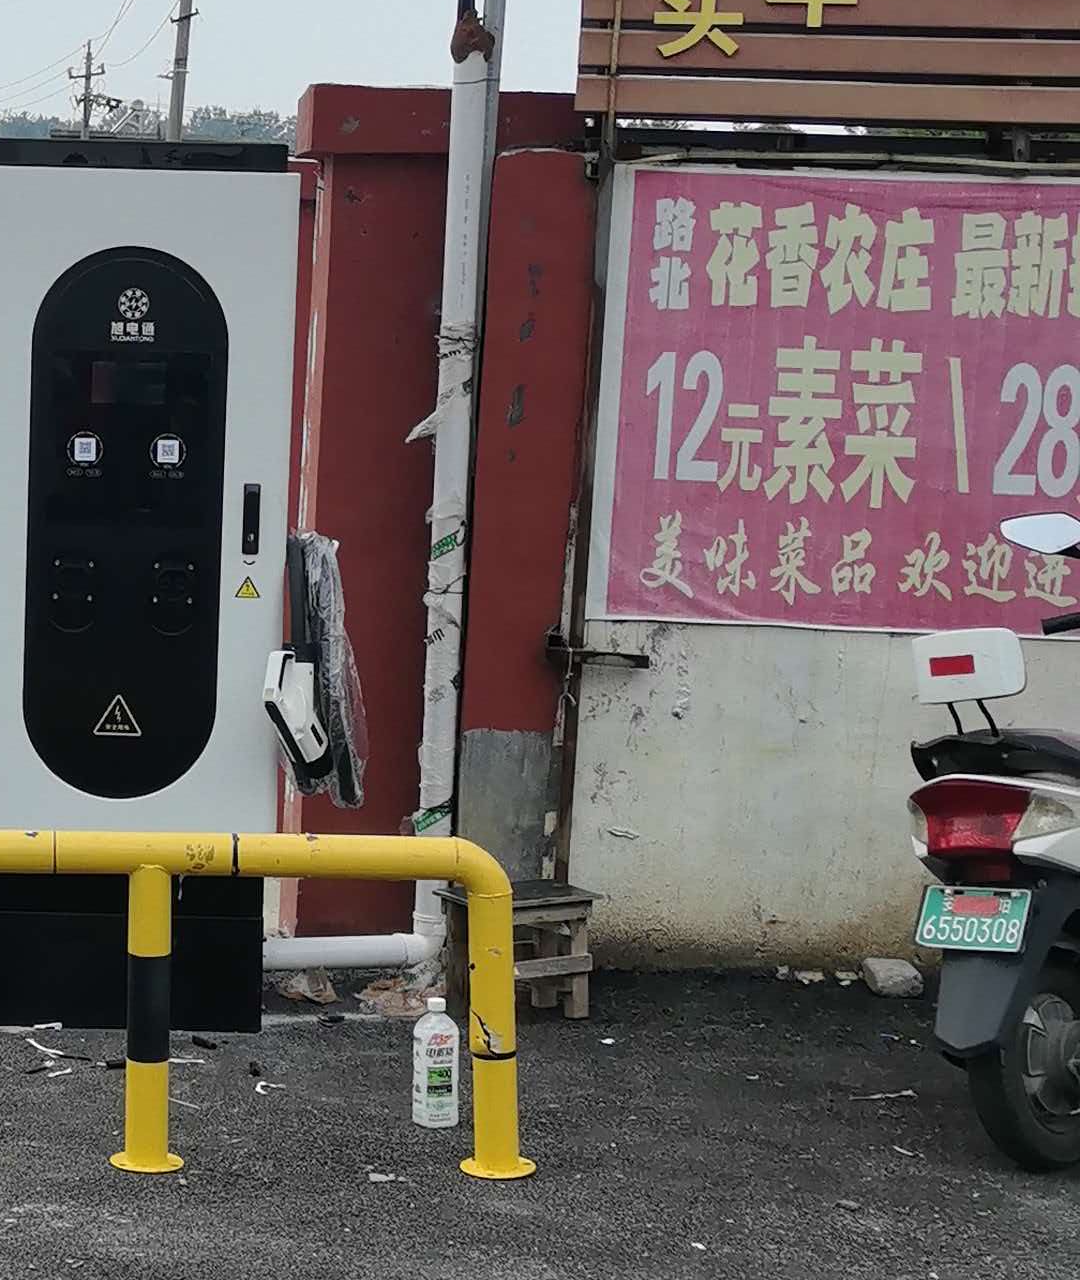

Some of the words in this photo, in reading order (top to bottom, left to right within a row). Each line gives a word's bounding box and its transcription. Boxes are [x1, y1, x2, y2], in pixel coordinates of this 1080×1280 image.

[648, 196, 696, 311] 路北
[706, 201, 935, 315] 花香农庄
[951, 209, 1080, 320] 最新
[111, 321, 155, 336] 旭电通
[639, 510, 876, 606] 美味菜品
[923, 915, 1020, 943] 6550308
